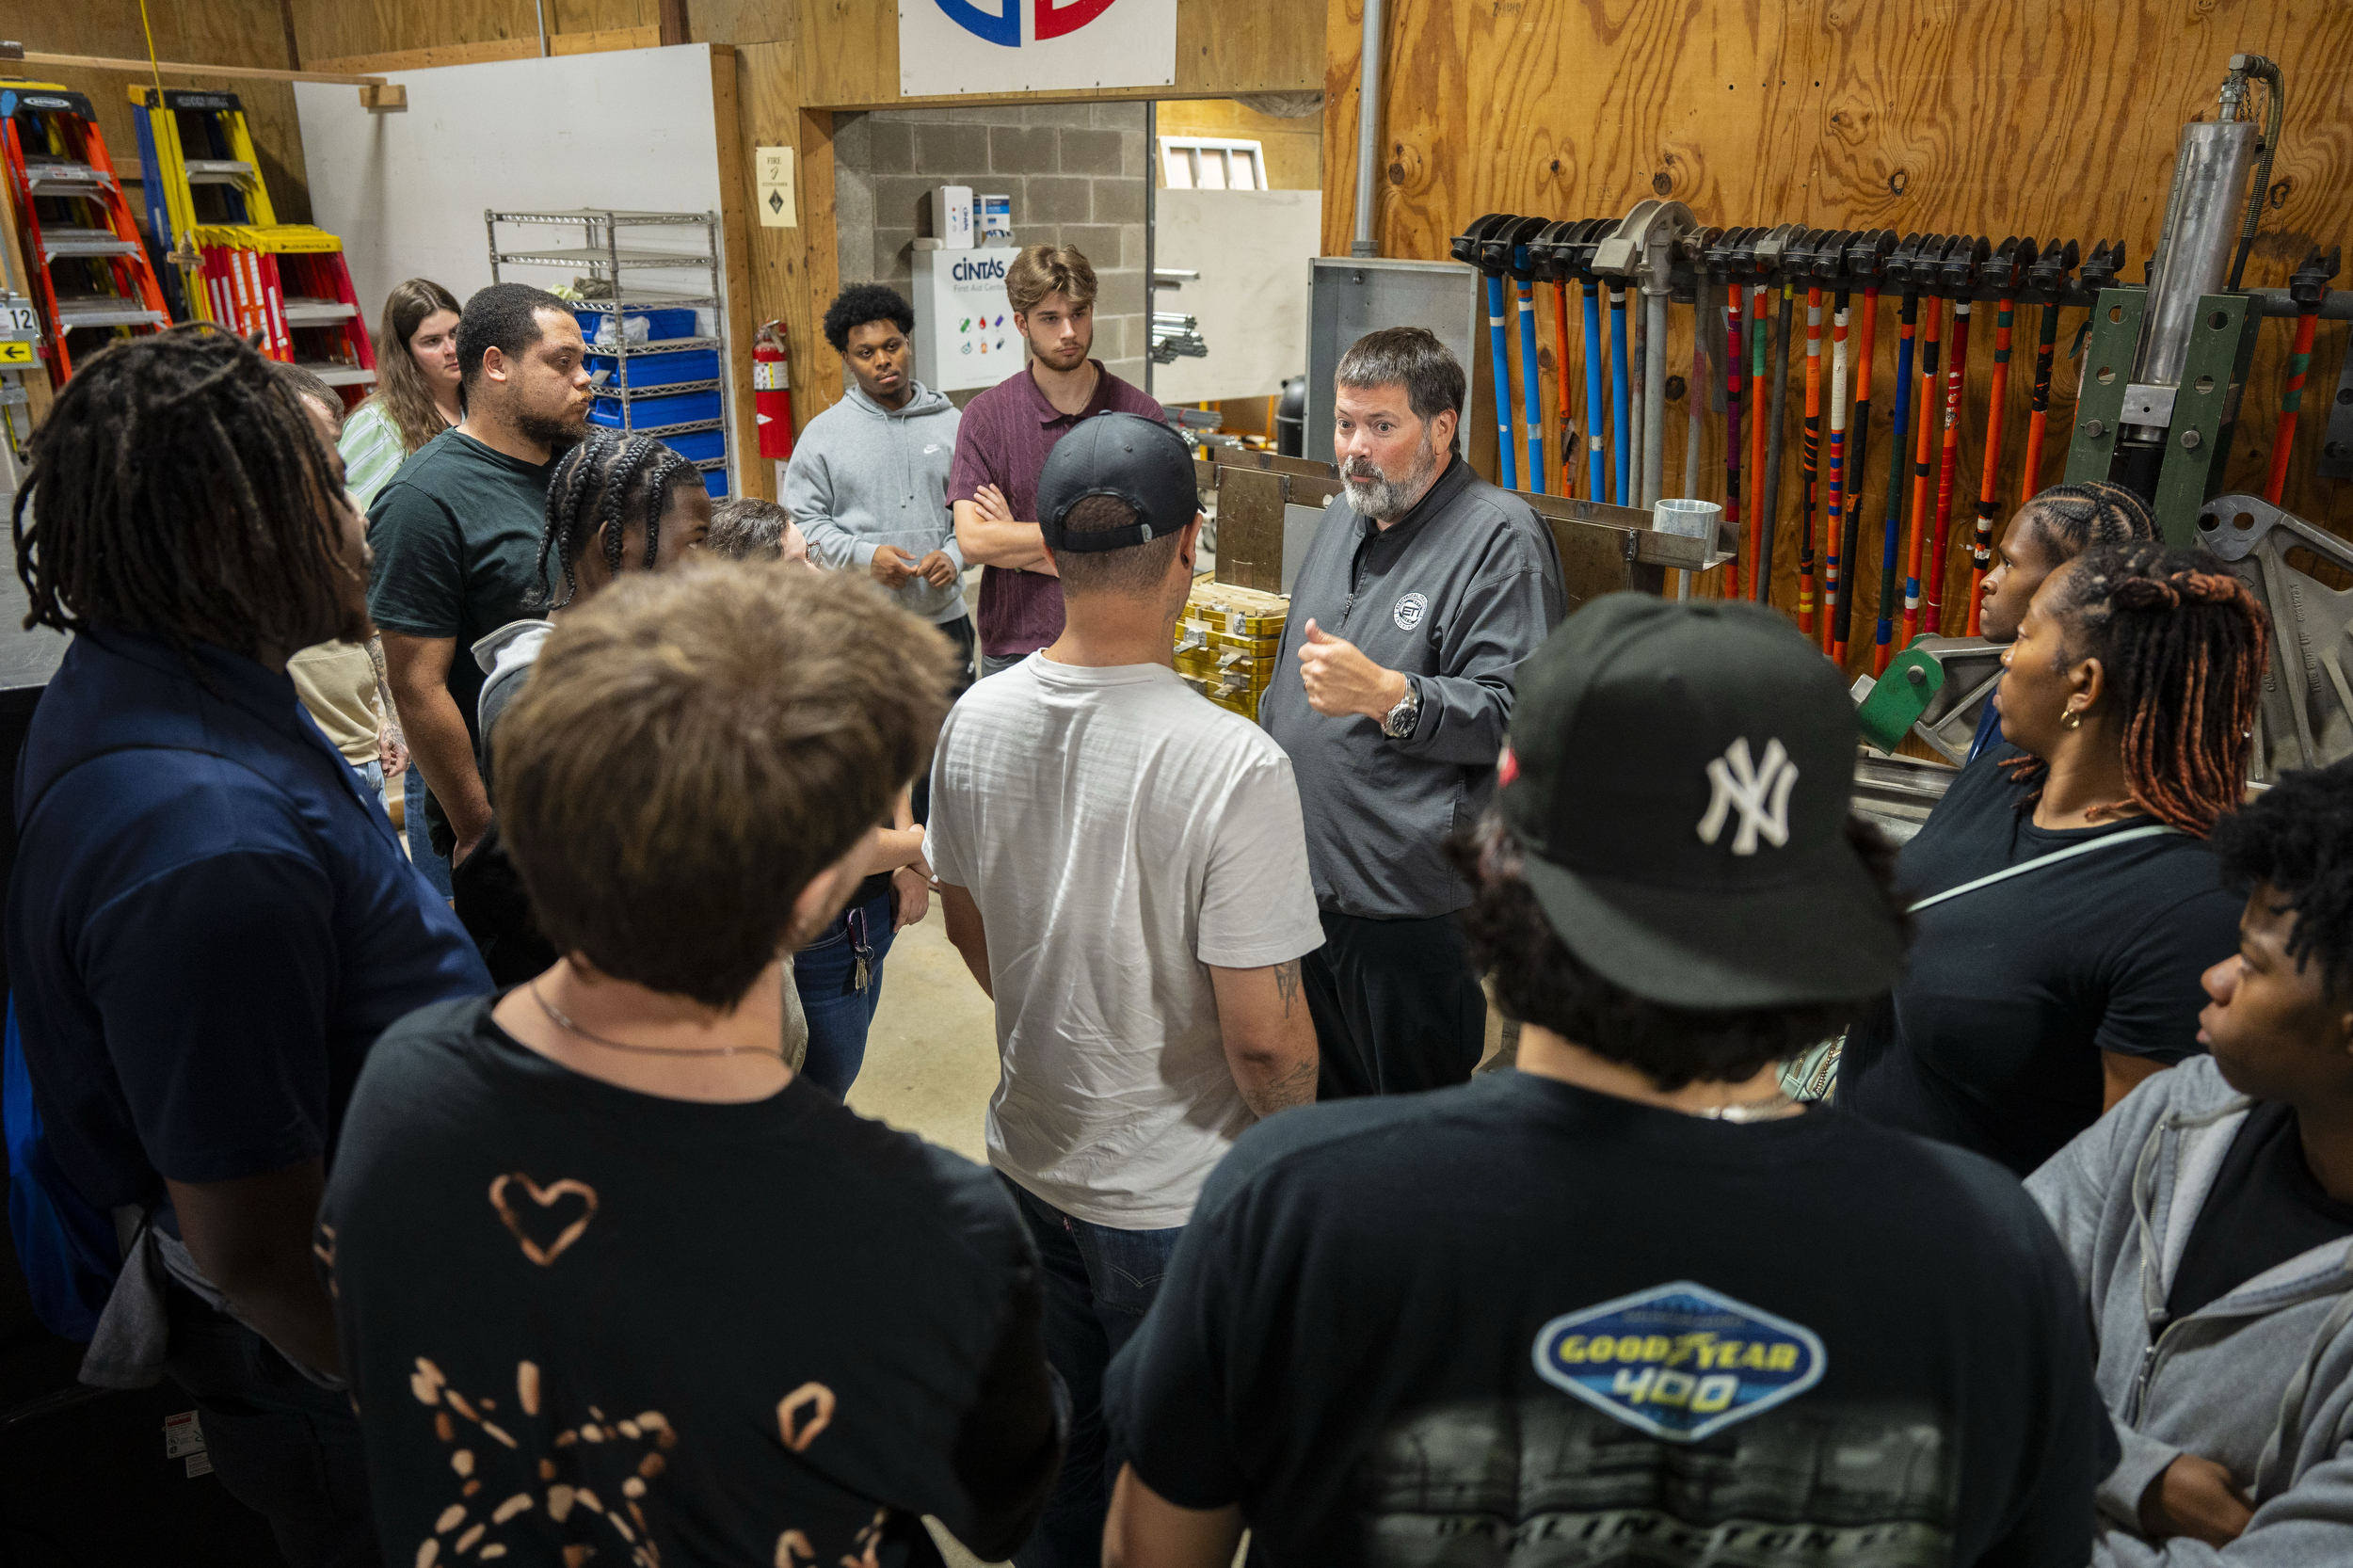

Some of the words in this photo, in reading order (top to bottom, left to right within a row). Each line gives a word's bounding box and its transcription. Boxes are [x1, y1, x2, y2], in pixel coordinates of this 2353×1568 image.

[767, 156, 781, 165] FIRE
[952, 256, 1005, 281] CINTAS
[953, 283, 968, 293] First
[970, 283, 983, 292] Aid
[9, 309, 33, 329] 12
[1611, 1367, 1739, 1413] 400
